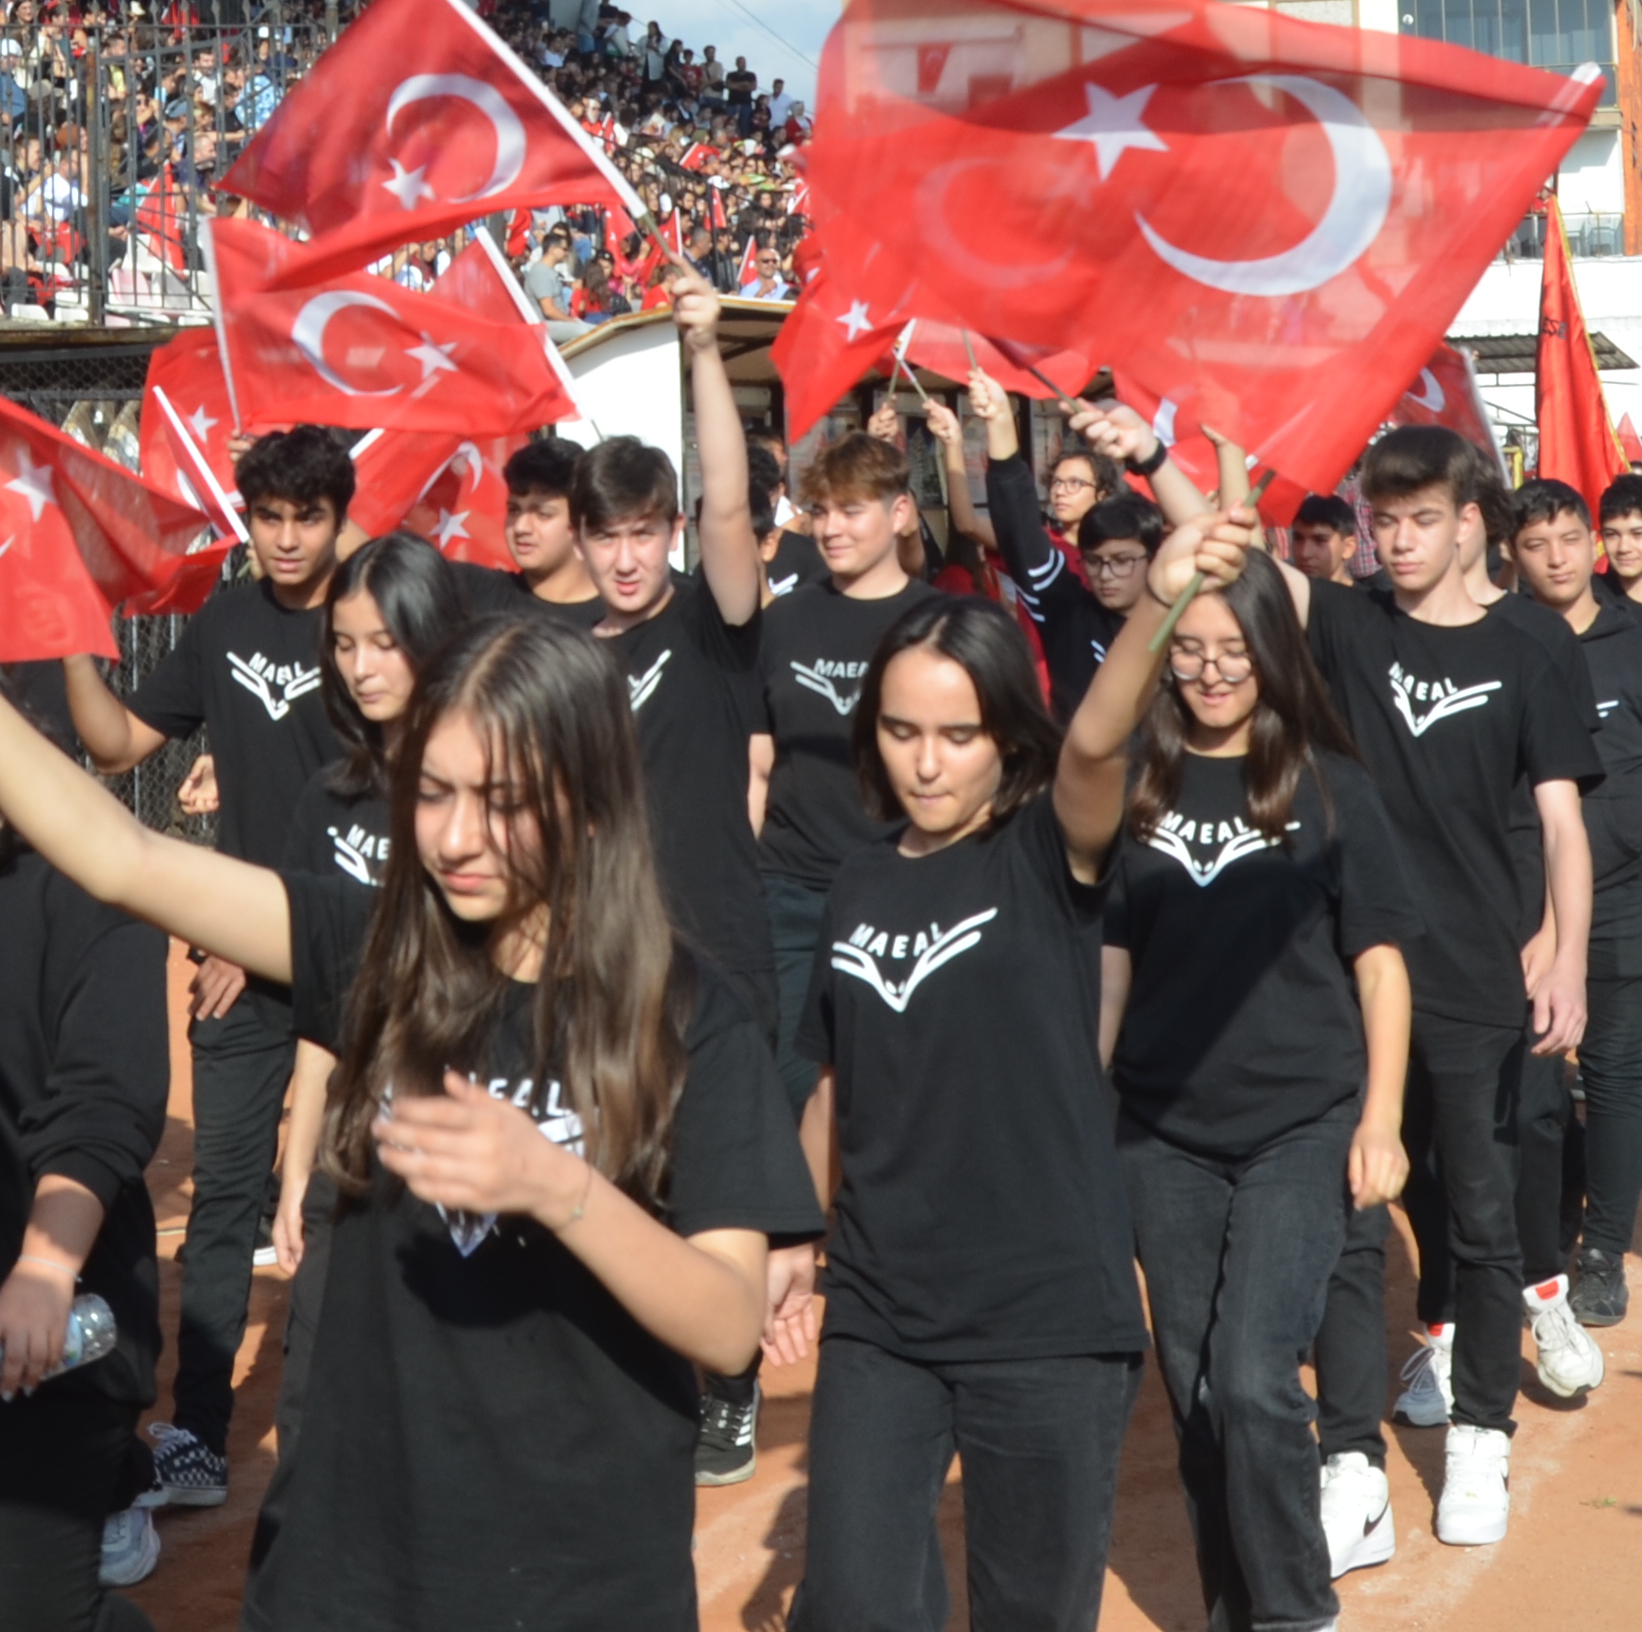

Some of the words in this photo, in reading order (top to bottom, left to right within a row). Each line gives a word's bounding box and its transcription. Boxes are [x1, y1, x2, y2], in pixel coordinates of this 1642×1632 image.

[814, 658, 868, 679] MAE
[345, 823, 392, 860] MAE
[1159, 810, 1250, 845] MAEAL
[848, 922, 944, 959] MAEAL
